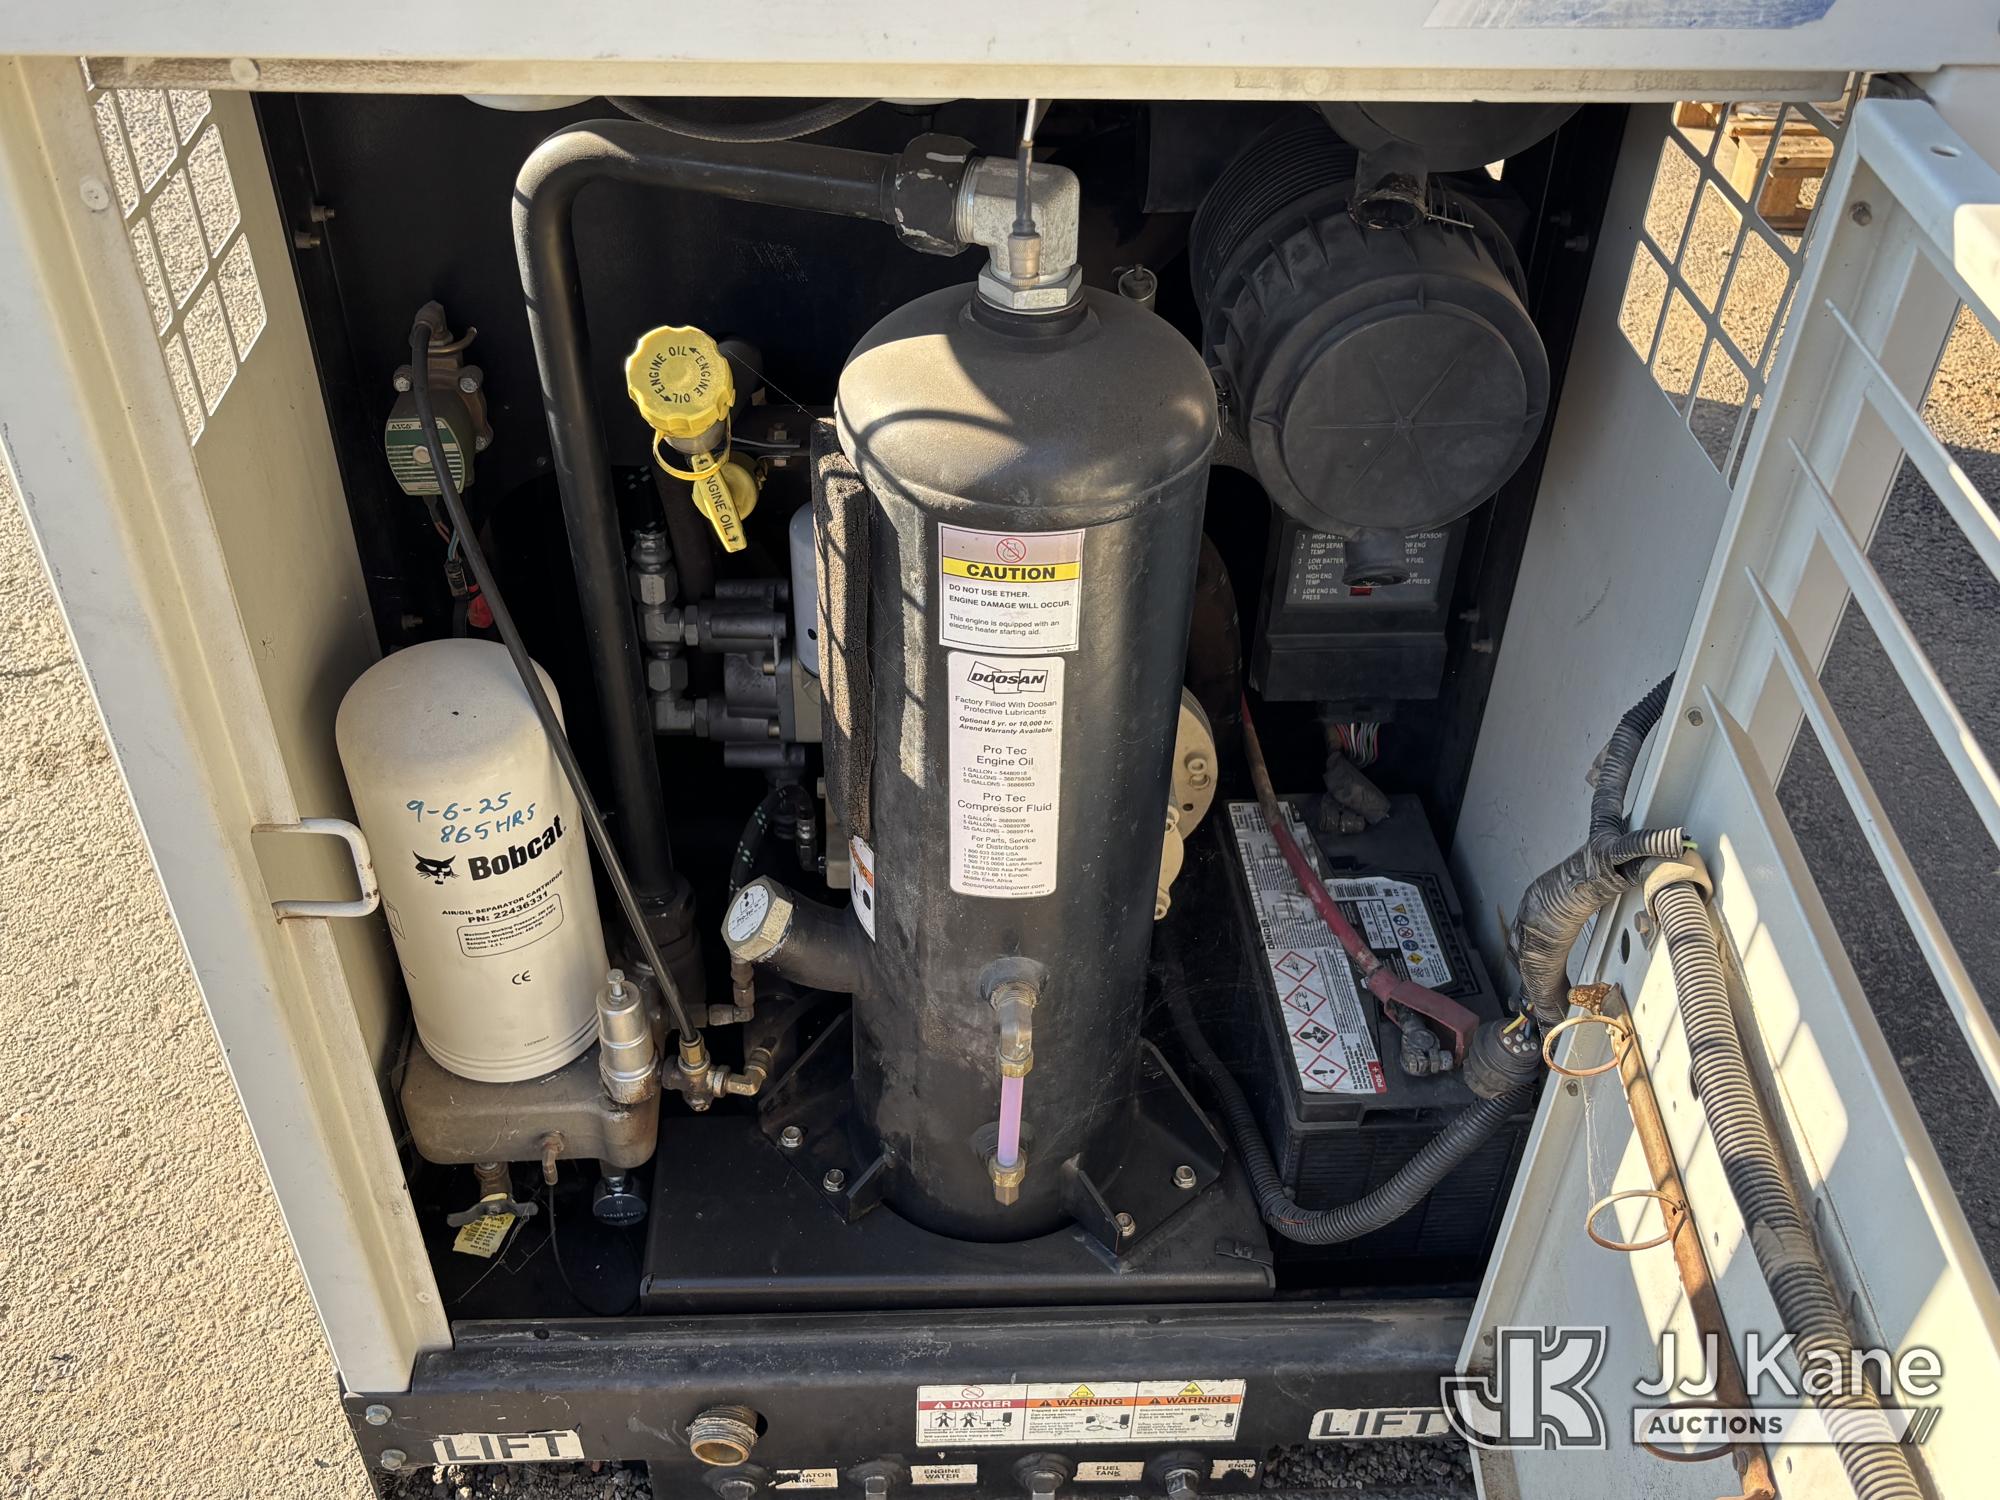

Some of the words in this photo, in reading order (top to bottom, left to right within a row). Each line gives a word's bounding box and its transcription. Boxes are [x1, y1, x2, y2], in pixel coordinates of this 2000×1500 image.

[649, 352, 667, 395] ENGINE
[669, 347, 687, 356] OIL
[695, 356, 711, 396] ENGINE
[673, 393, 690, 403] OIL
[720, 515, 736, 536] OIL
[967, 564, 1055, 579] CAUTION
[950, 584, 960, 592] DO
[963, 586, 979, 595] NOT
[982, 589, 997, 597] USE
[950, 596, 978, 605] ENGINE
[950, 614, 963, 622] This
[965, 618, 988, 626] engine
[999, 621, 1032, 629] equipped
[949, 622, 973, 631] electric
[975, 626, 997, 634] heater
[971, 673, 1044, 684] DOOSAN
[955, 696, 983, 706] Factory
[964, 705, 1002, 715] Protective
[960, 716, 989, 725] Optional
[959, 724, 982, 732] Airend
[985, 727, 1017, 735] Warranty
[983, 745, 1002, 754] Pro
[977, 756, 1015, 767] Engine
[1019, 757, 1033, 765] Oil
[983, 793, 1001, 801] Pro
[1005, 794, 1026, 802] Tec
[406, 792, 512, 822] 9-6-25
[958, 800, 1023, 813] Compressor
[1026, 803, 1052, 812] Fluid
[968, 820, 996, 828] GALLONS
[468, 814, 564, 881] Bobcat
[476, 896, 524, 914] SEPARATOR
[526, 870, 563, 899] CARTRIDGE
[962, 882, 1044, 890] doosanportablepower.com
[468, 913, 490, 923] PN:
[494, 891, 548, 920] 22436331
[1261, 920, 1276, 950] DANGER
[1166, 1396, 1231, 1404] WARNING
[1320, 1410, 1444, 1436] LIFT
[443, 1433, 567, 1460] LIFT
